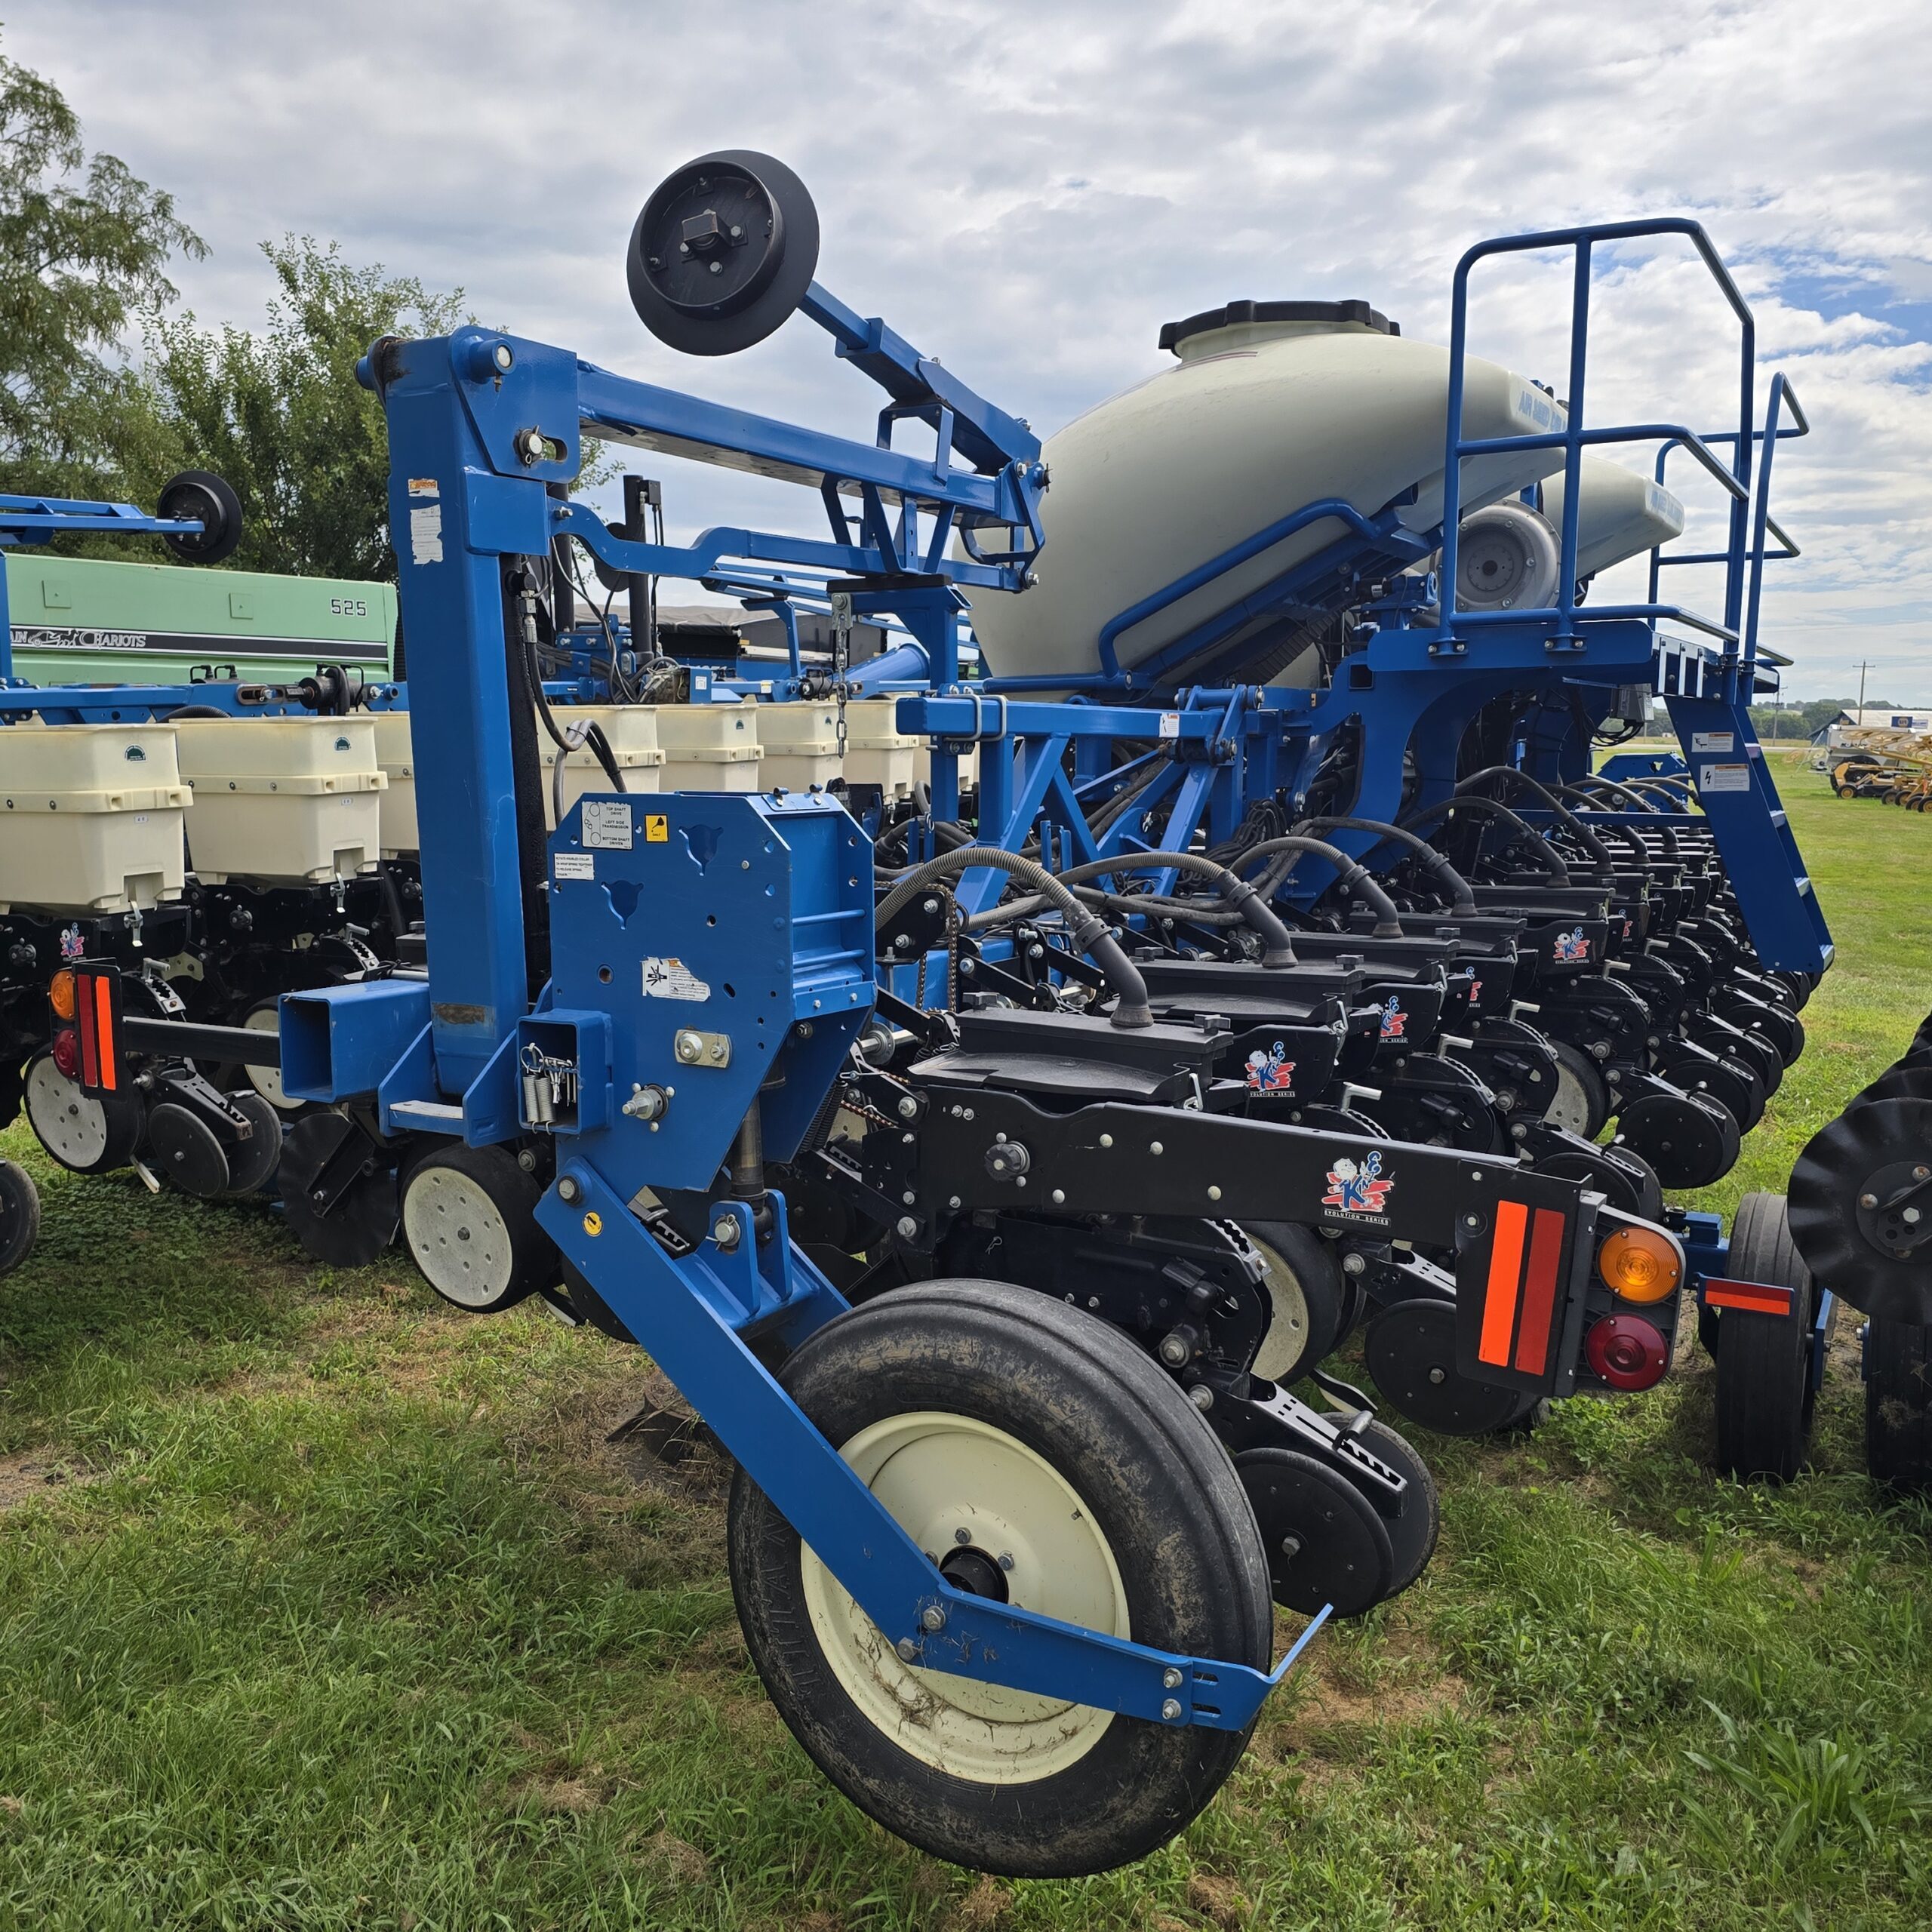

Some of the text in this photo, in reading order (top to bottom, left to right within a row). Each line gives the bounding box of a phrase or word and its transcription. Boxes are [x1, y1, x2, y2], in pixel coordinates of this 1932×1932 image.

[330, 598, 368, 617] 525
[10, 630, 28, 643] AIN
[1324, 1209, 1389, 1226] EVOLUTION SERIES
